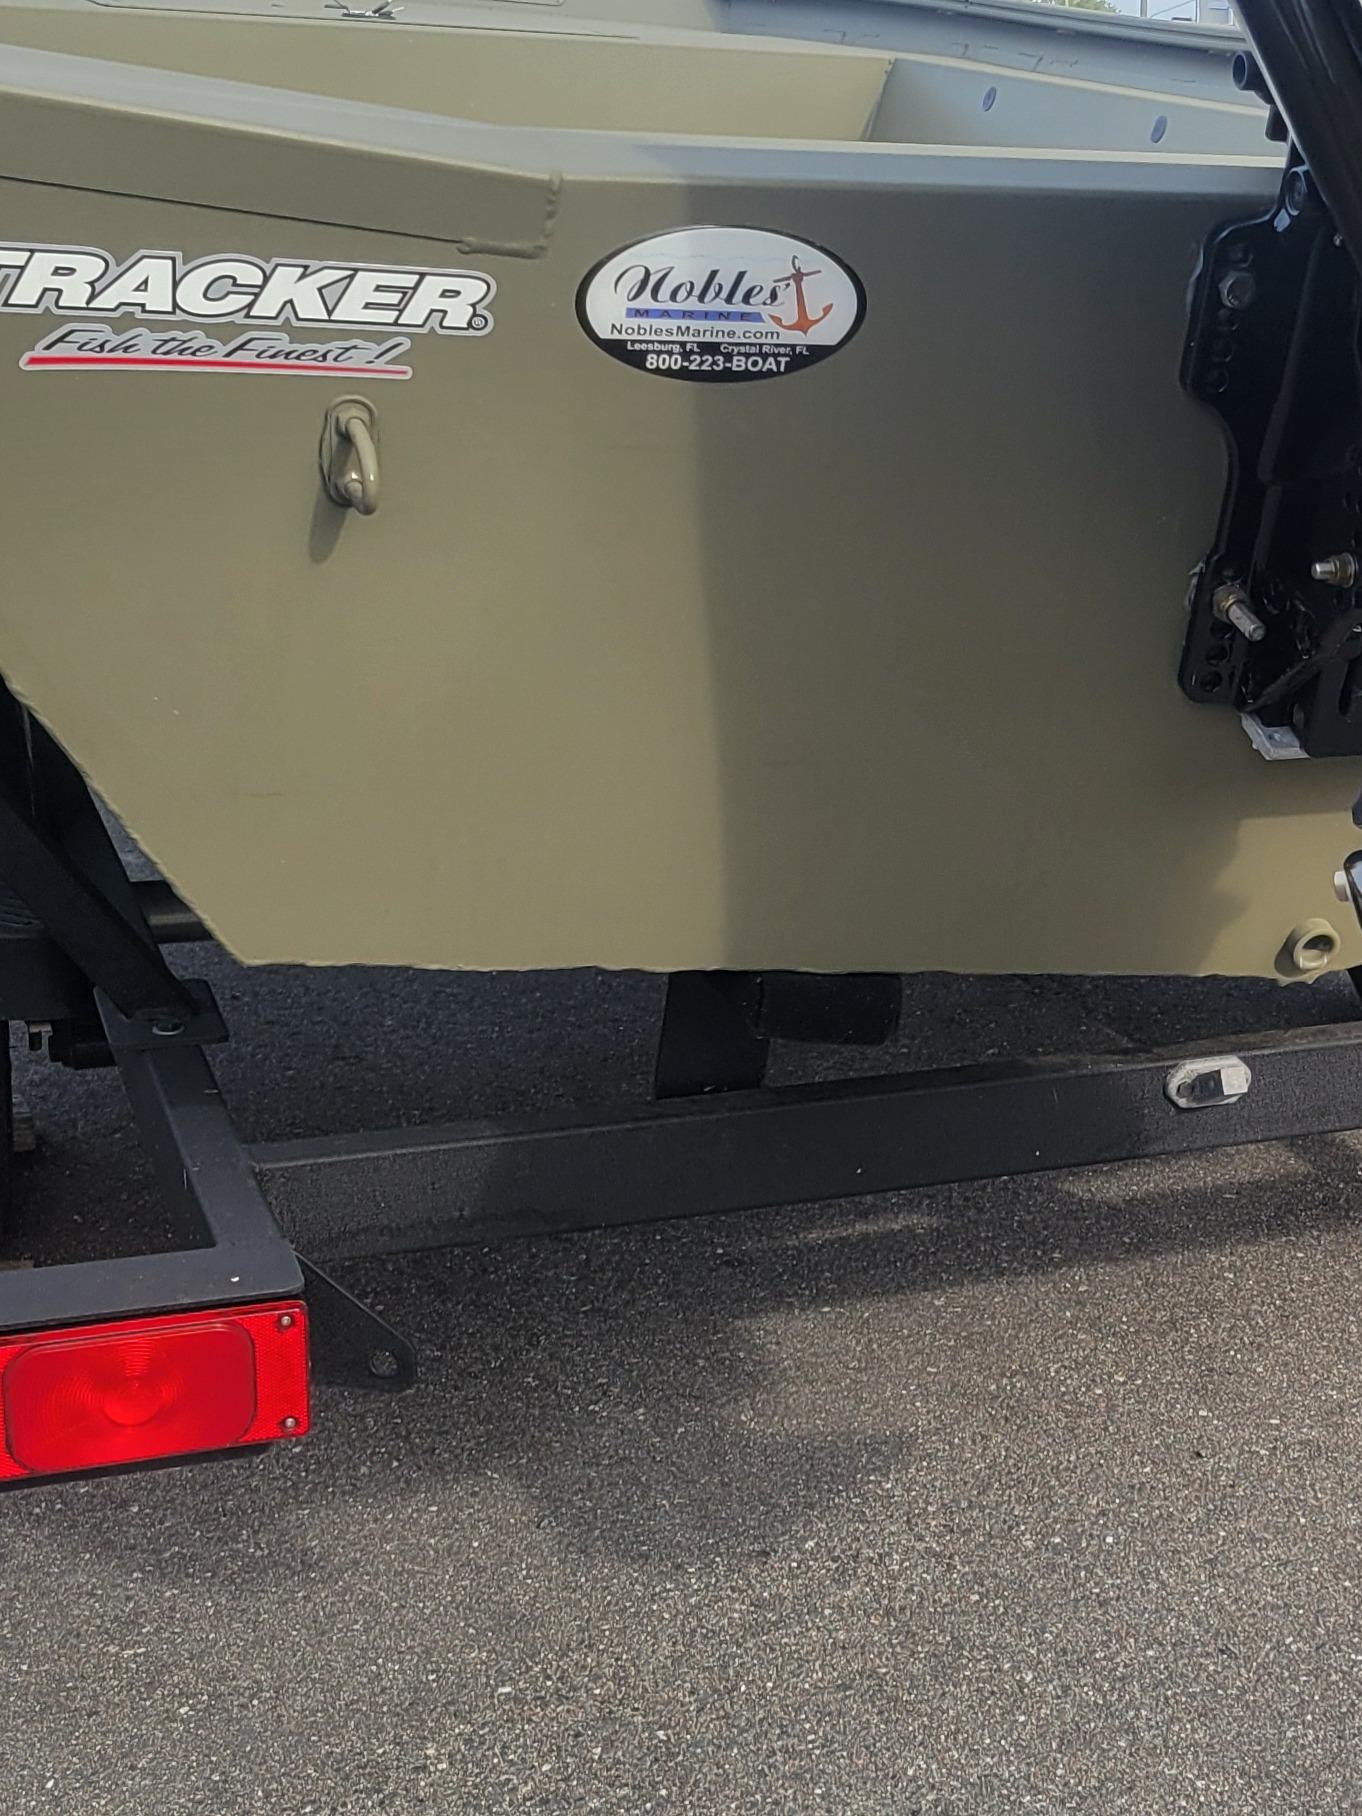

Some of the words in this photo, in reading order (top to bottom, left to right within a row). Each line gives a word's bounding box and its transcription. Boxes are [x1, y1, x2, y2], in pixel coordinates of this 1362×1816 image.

[633, 309, 754, 321] MARINE
[610, 323, 781, 340] NoblesMarine.com
[42, 329, 143, 353] Fish
[150, 336, 218, 357] the
[686, 342, 701, 353] FL
[720, 343, 760, 356] Crystal
[796, 346, 810, 356] FL
[645, 353, 791, 373] 800-223-BOAT
